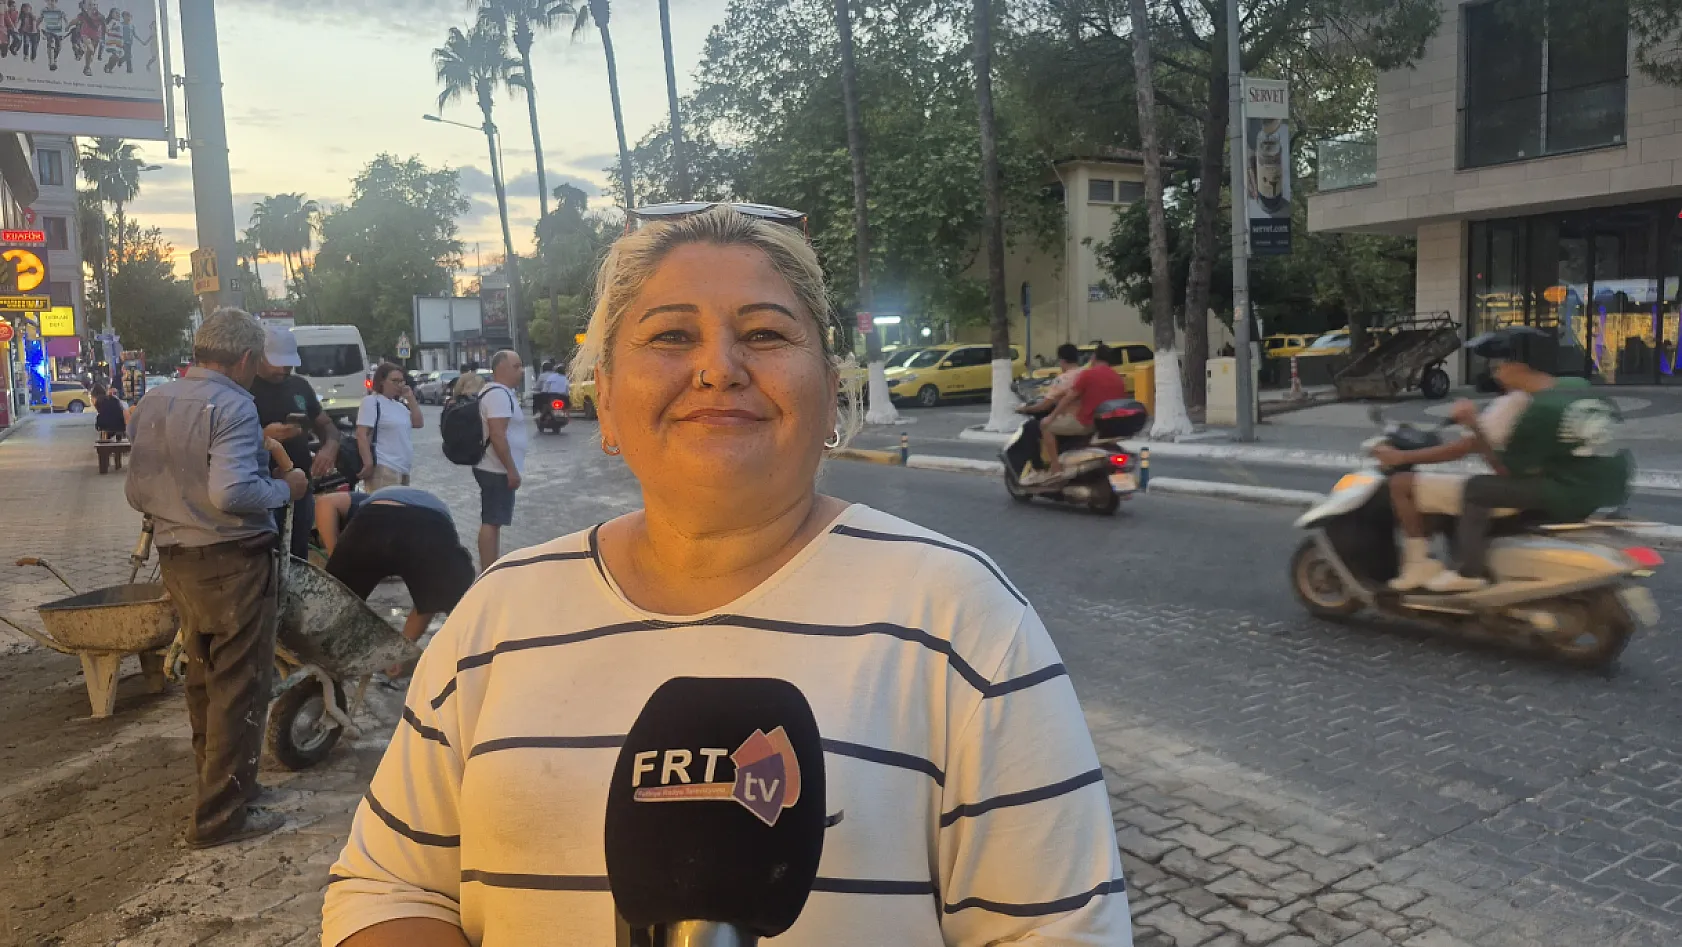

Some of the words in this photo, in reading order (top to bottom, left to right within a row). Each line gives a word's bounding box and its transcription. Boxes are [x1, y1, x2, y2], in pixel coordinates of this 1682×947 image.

[1249, 86, 1285, 104] SERVET
[1252, 224, 1289, 233] servet.com
[631, 747, 729, 788] FRT
[743, 771, 780, 803] tv
[662, 787, 684, 796] Radyo
